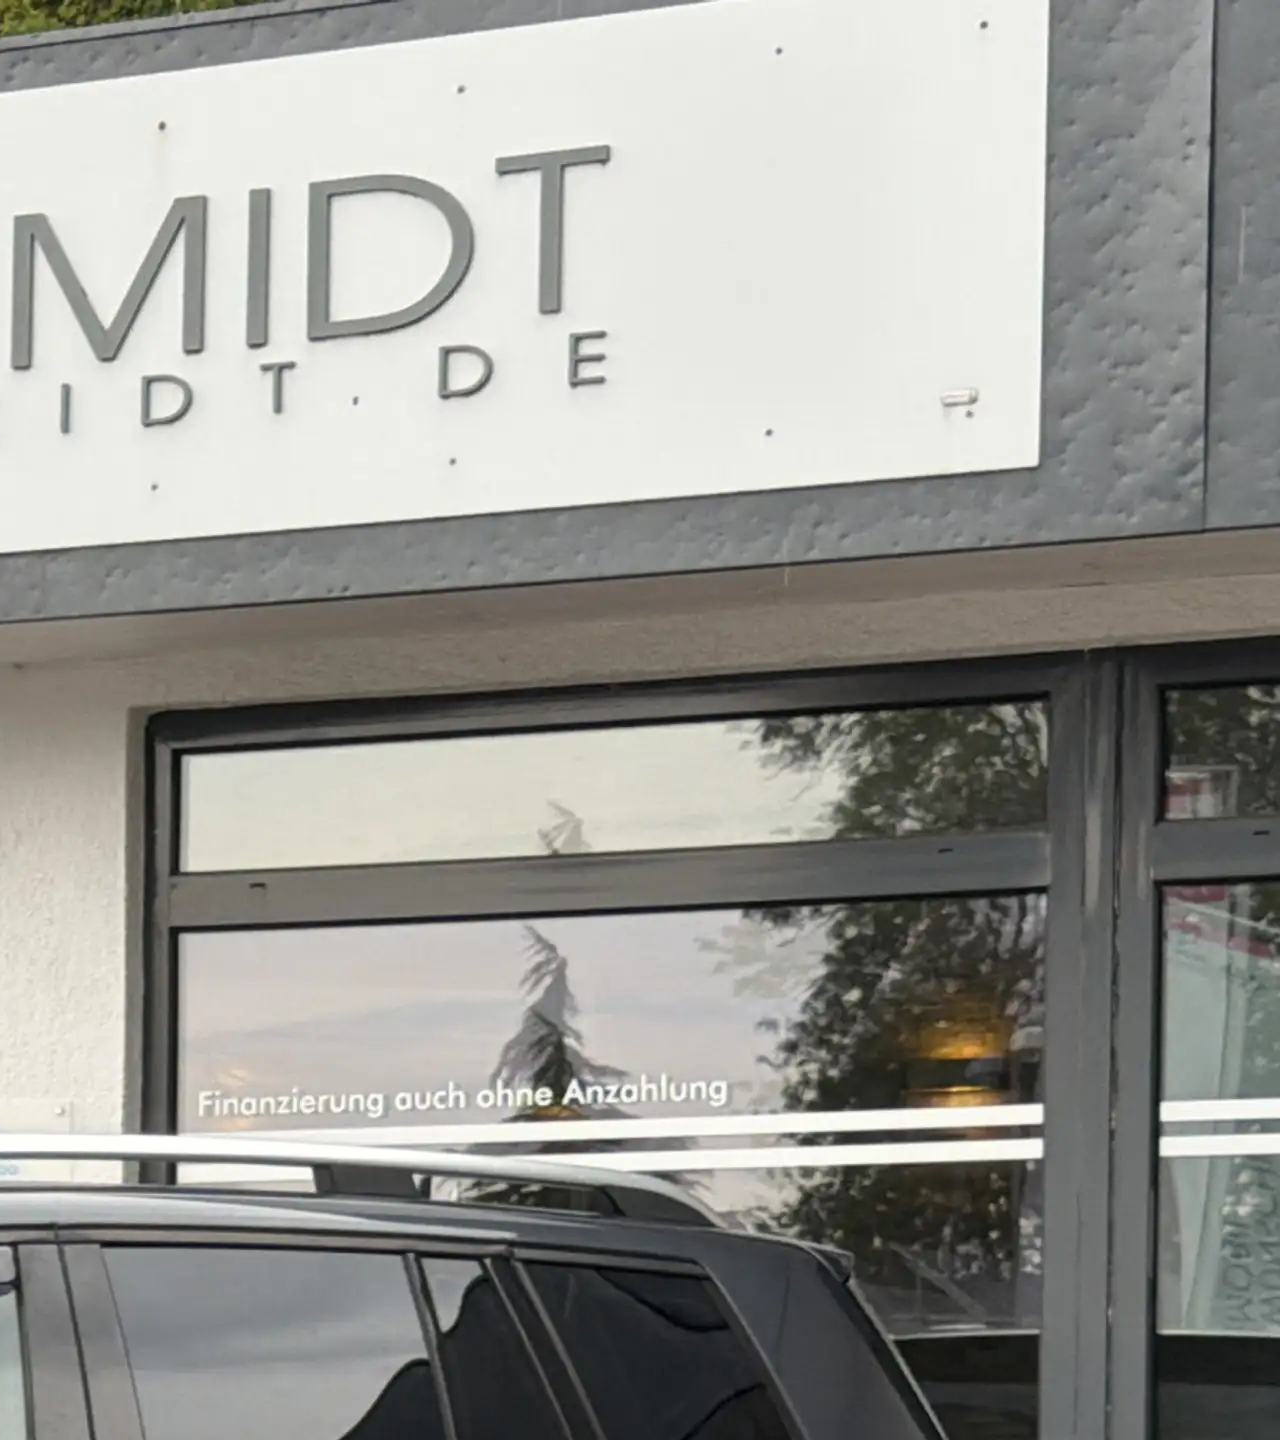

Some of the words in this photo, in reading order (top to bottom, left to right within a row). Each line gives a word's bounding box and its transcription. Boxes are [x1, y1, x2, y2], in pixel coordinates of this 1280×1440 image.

[197, 1086, 384, 1119] Finanzierung
[395, 1083, 467, 1112] auch
[477, 1081, 554, 1110] ohne
[562, 1075, 728, 1109] Anzahlung
